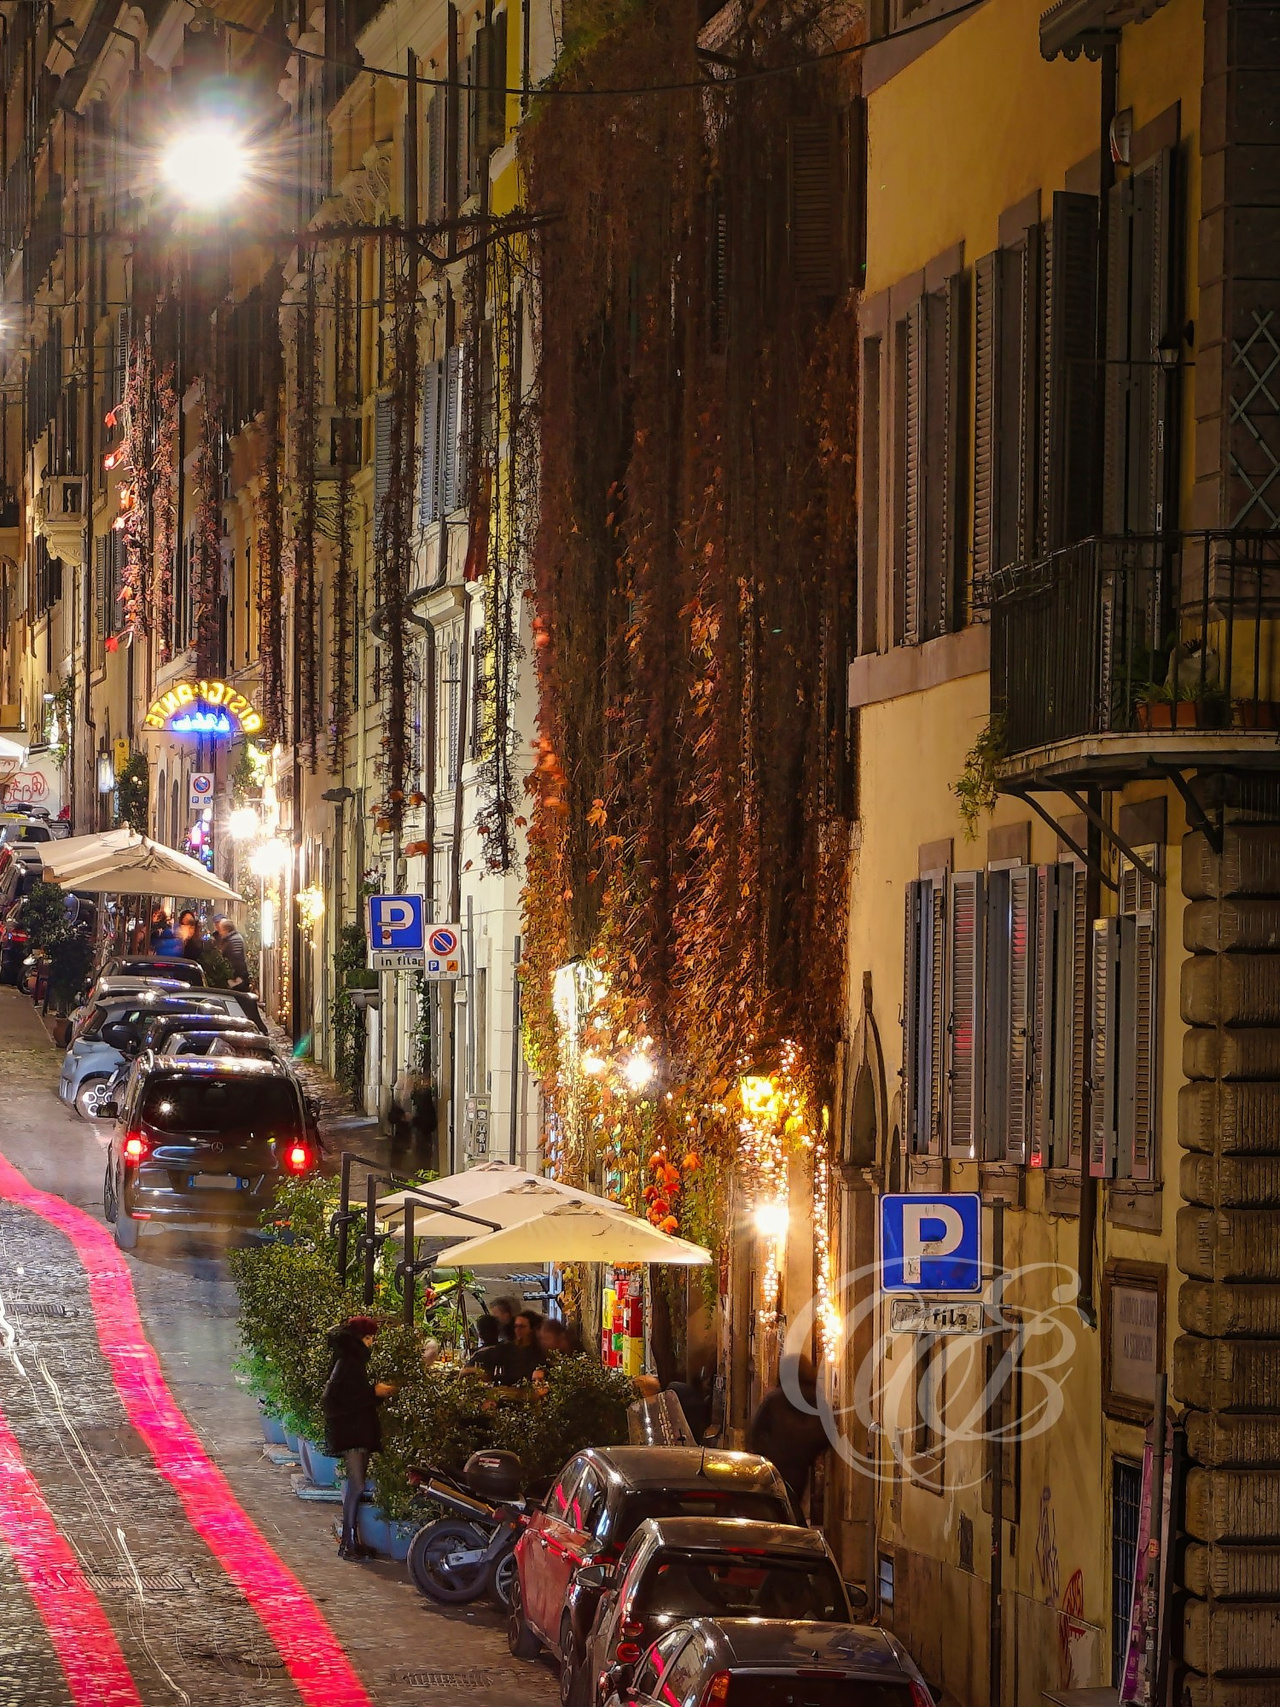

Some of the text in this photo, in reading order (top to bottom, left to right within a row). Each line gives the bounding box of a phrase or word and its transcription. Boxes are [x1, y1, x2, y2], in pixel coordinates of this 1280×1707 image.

[381, 900, 414, 945] P
[381, 956, 418, 966] in fila
[430, 962, 438, 970] P
[903, 1204, 964, 1284] P
